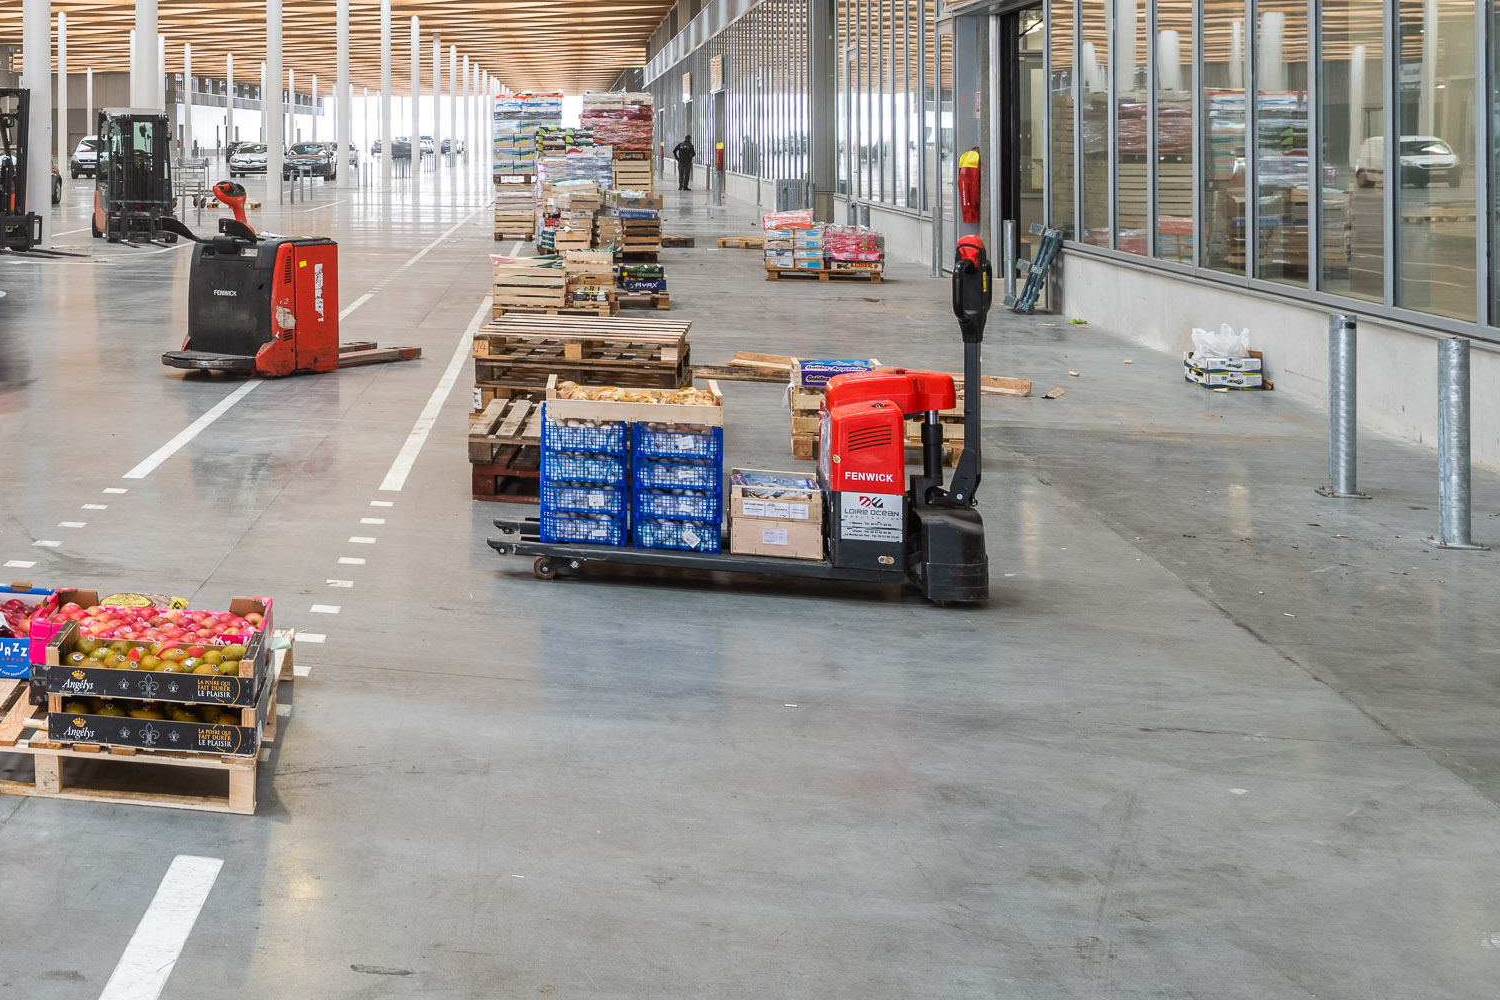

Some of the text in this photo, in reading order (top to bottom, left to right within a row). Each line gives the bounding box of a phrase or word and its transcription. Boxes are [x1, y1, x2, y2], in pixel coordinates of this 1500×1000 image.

[213, 289, 237, 297] FENWICK
[844, 472, 894, 482] FENWICK
[62, 678, 94, 691] Angélys
[63, 726, 95, 739] Angélys
